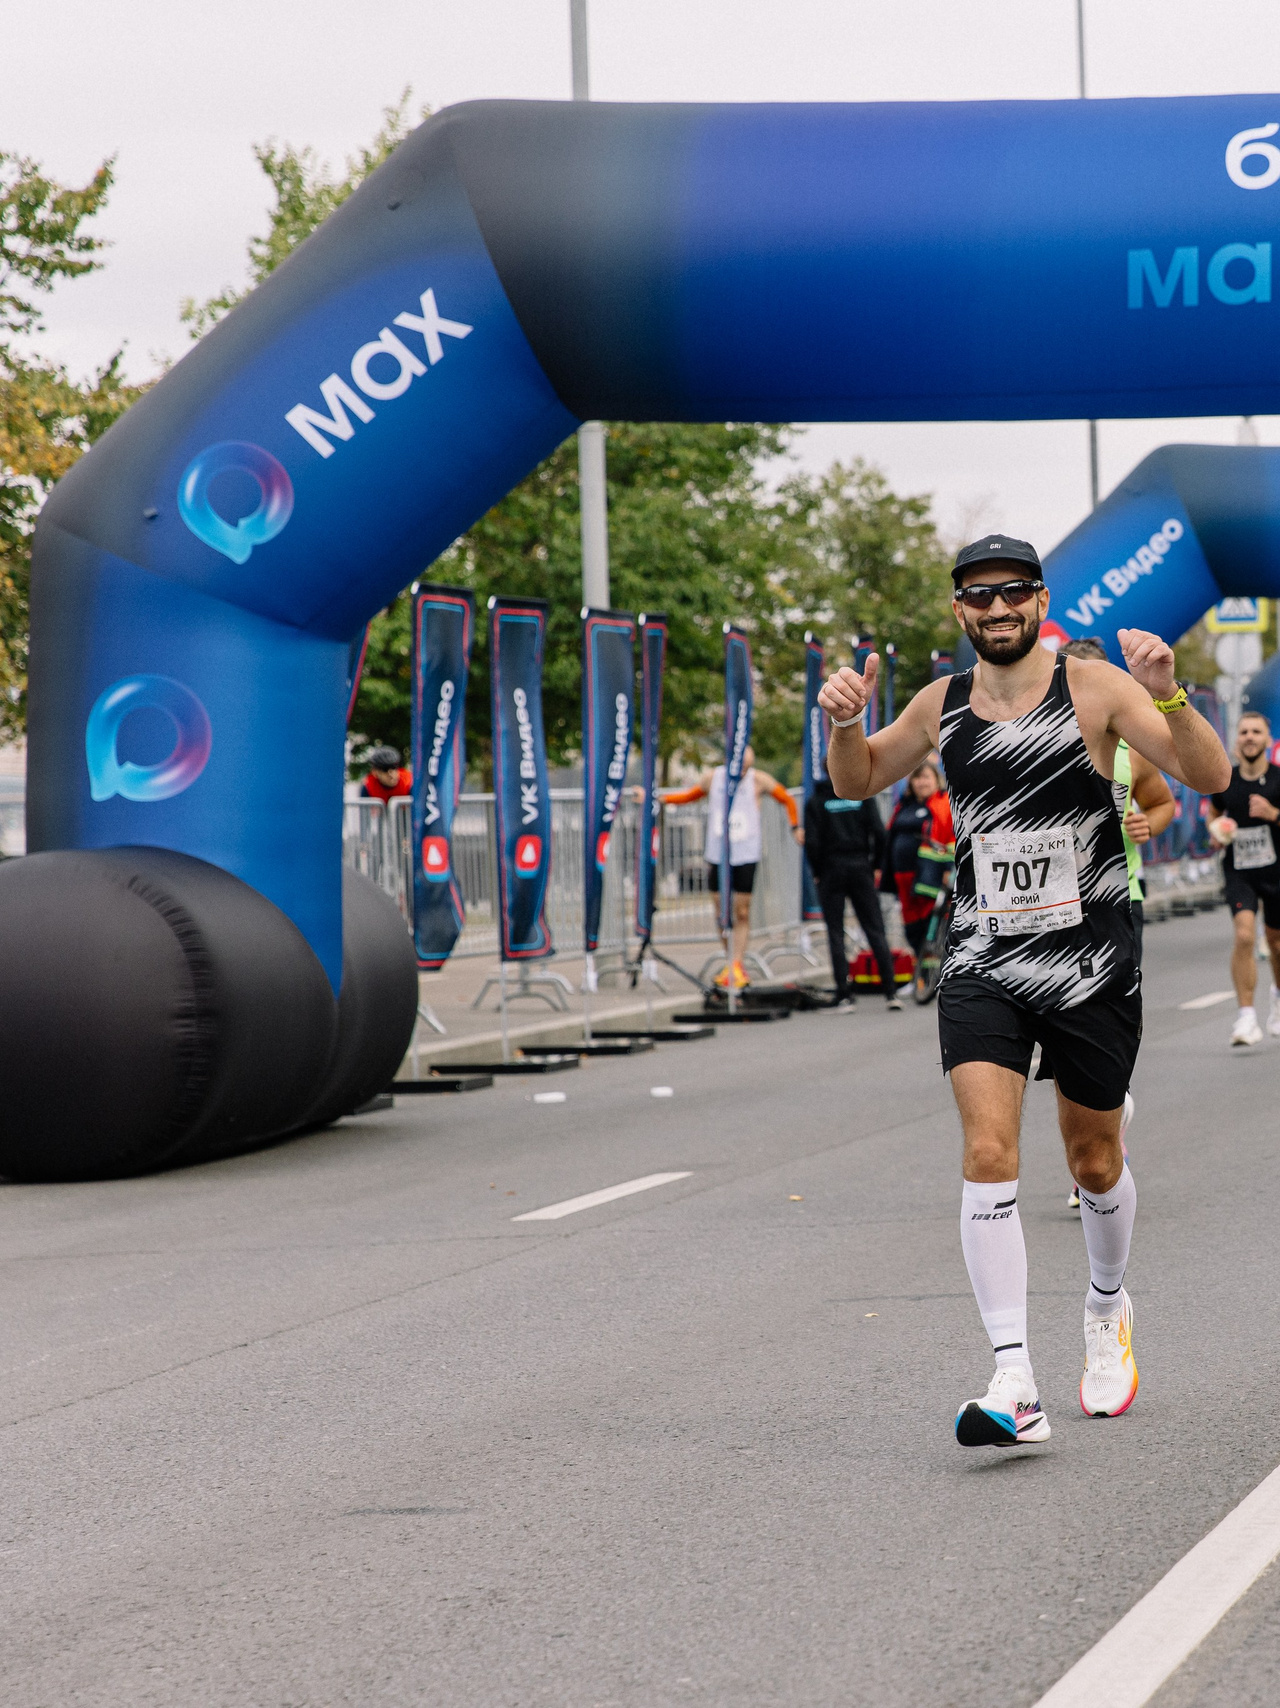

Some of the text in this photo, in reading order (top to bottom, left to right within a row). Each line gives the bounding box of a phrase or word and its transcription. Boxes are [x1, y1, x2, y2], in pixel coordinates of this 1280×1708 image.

[1065, 518, 1184, 627] VK Видео
[513, 688, 539, 825] VK Видео
[1019, 843, 1044, 855] 42,2
[992, 857, 1051, 892] 707
[1011, 894, 1040, 905] ЮРИЙ
